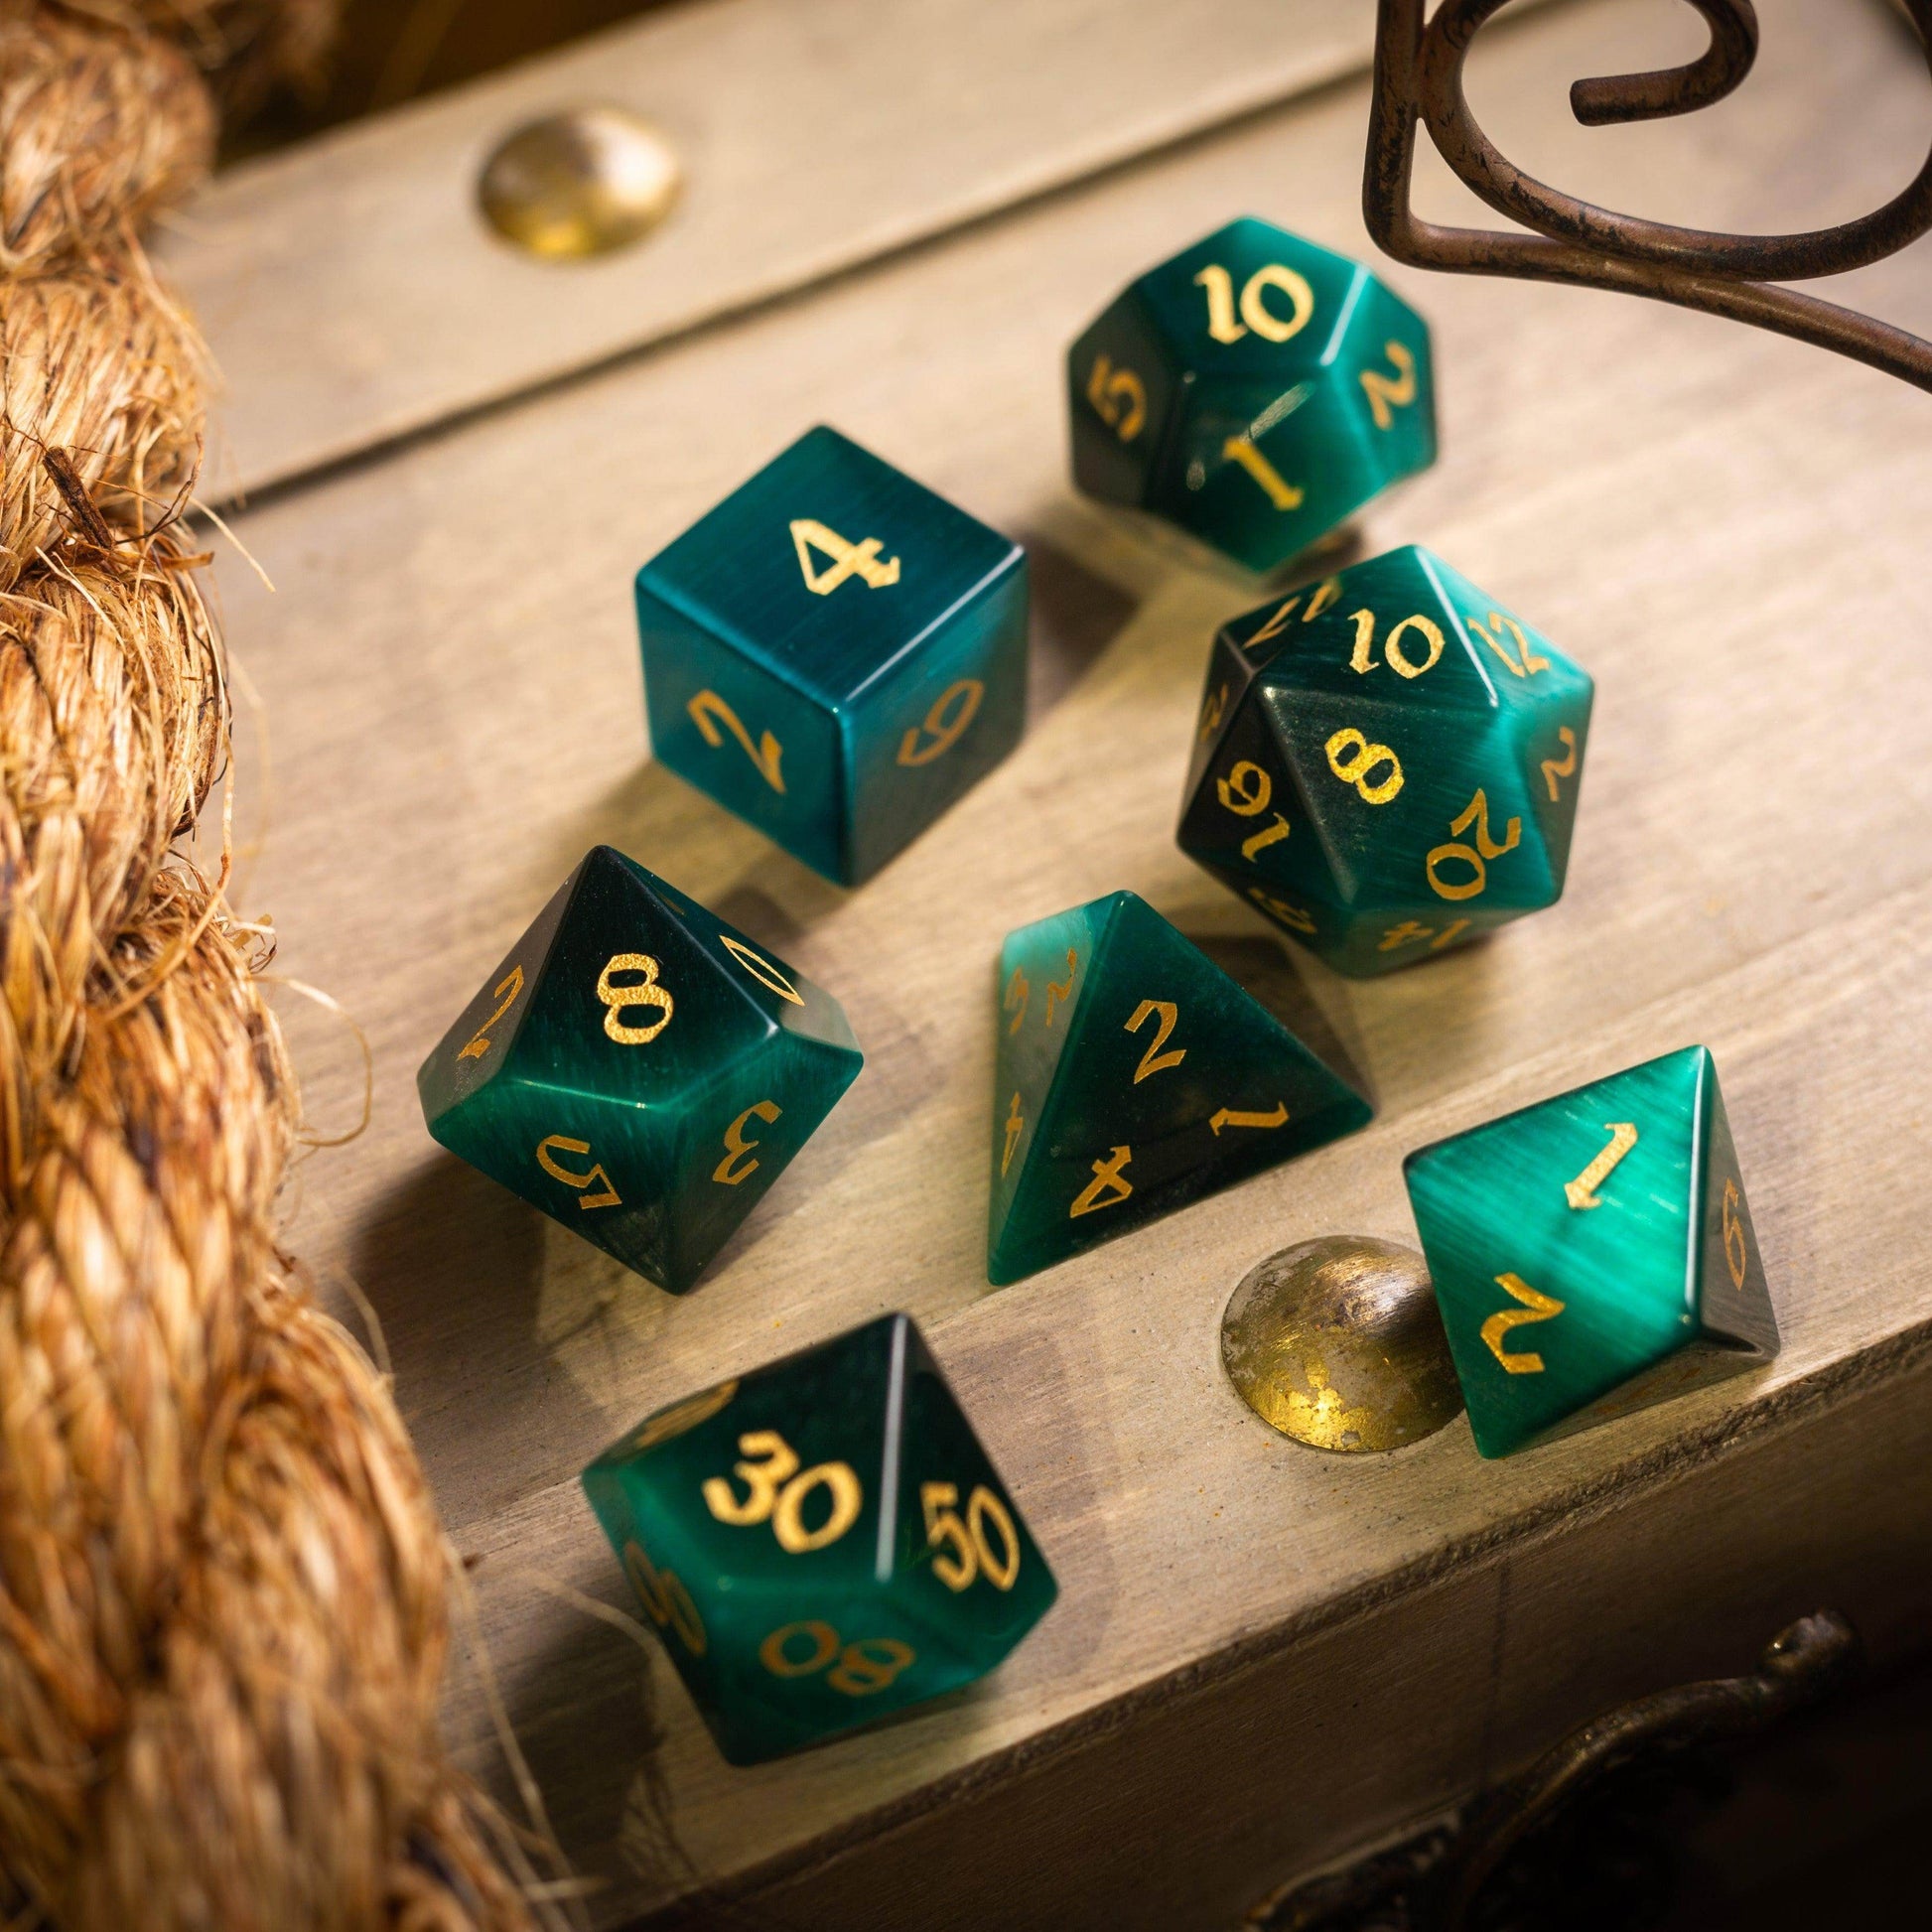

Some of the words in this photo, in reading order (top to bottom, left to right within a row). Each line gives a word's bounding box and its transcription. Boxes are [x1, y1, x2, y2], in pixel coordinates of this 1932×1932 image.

[1194, 263, 1314, 345] 10
[1087, 353, 1146, 442] 5
[1359, 340, 1416, 430] 2
[1222, 436, 1304, 511] 1
[789, 519, 899, 596] 4
[1348, 609, 1446, 679] 10
[1466, 611, 1550, 677] 12
[687, 689, 786, 794] 2
[1324, 728, 1404, 804] 8
[1541, 726, 1576, 802] 2
[1217, 760, 1290, 863] 16
[1426, 788, 1521, 900] 20
[597, 953, 674, 1044] 8
[1124, 1000, 1186, 1085] 2
[712, 1099, 783, 1185] 3
[1208, 1101, 1290, 1137] 1
[536, 1134, 622, 1209] 5
[1070, 1146, 1133, 1218] 4
[1564, 1123, 1638, 1210] 1
[1480, 1272, 1566, 1374] 2
[702, 1429, 863, 1554] 30
[920, 1480, 1020, 1591] 50
[759, 1620, 915, 1695] 80
